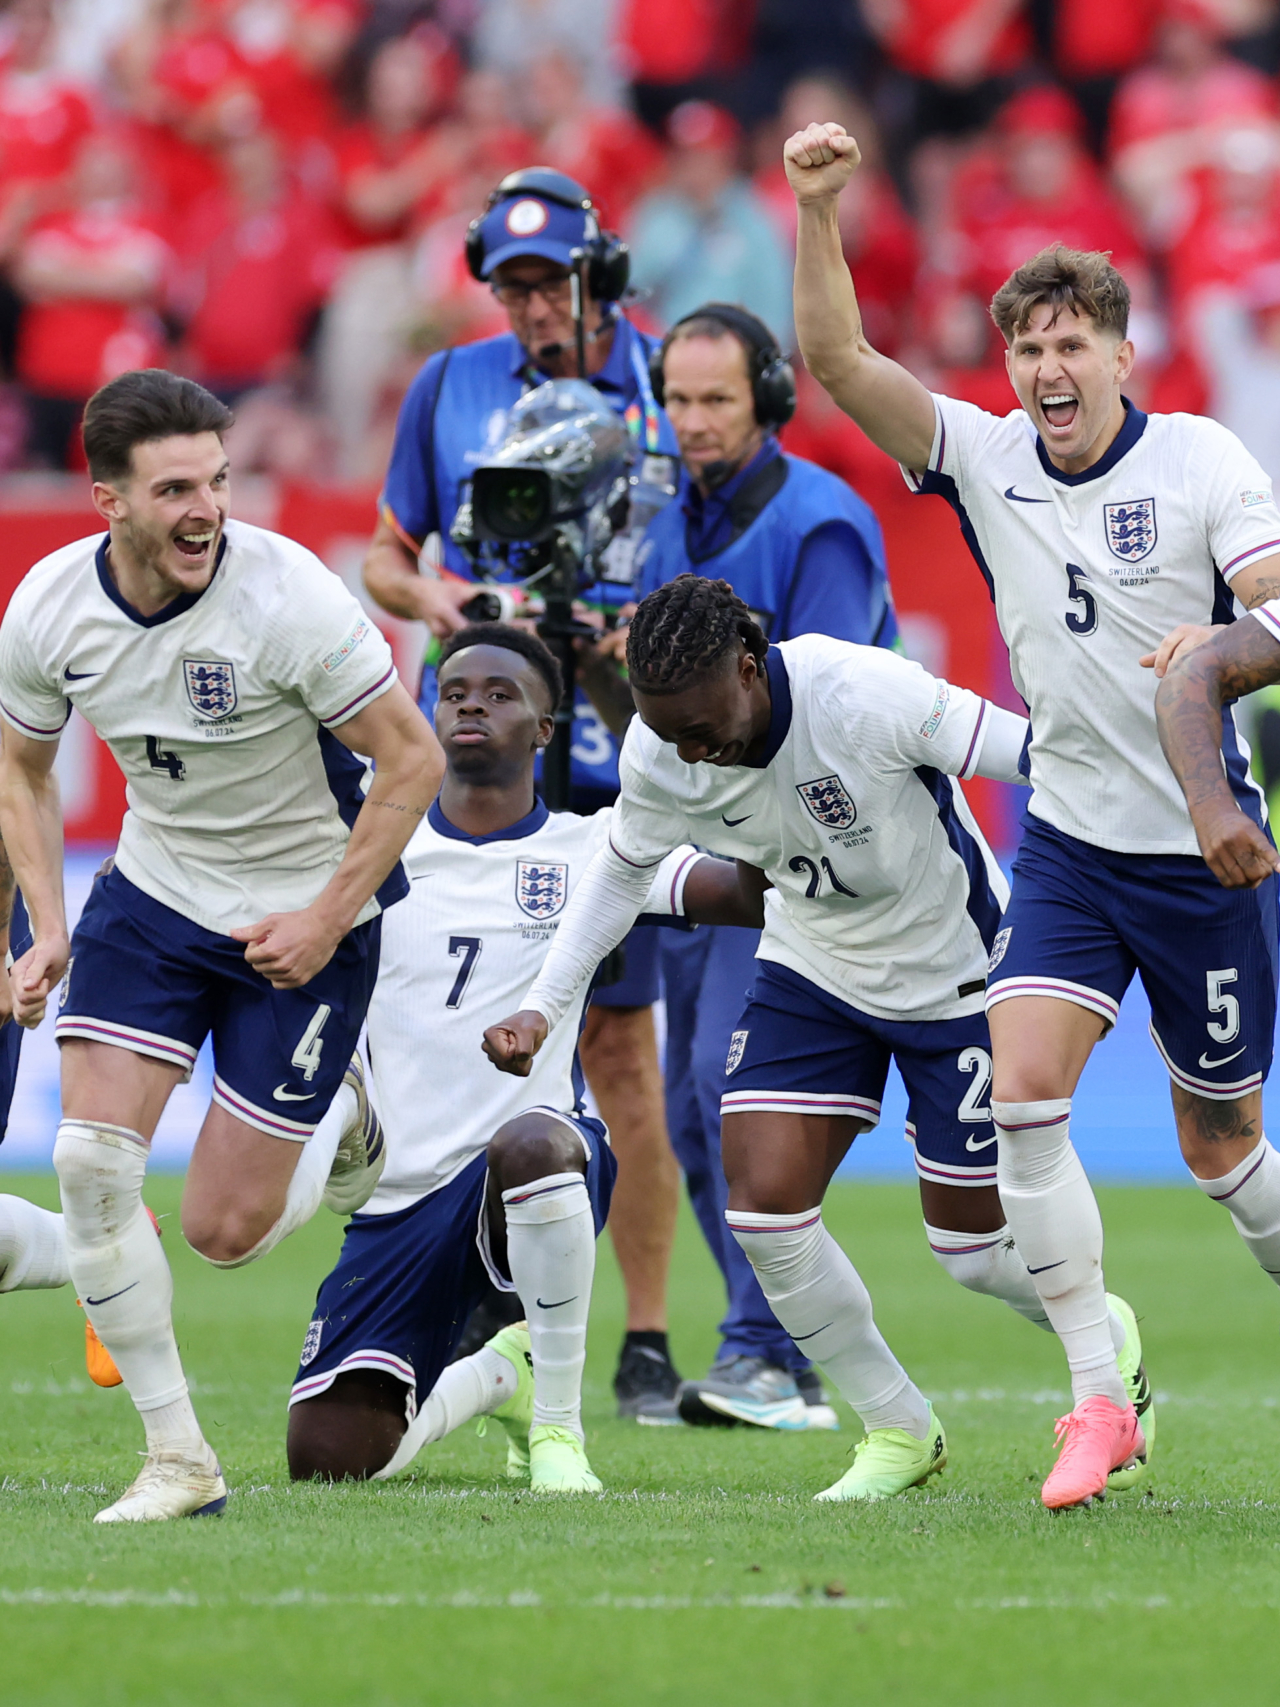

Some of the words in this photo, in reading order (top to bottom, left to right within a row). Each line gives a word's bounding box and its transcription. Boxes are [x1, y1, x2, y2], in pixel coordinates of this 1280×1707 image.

[1109, 566, 1159, 576] SWITZERLAND
[1120, 578, 1149, 586] 06.07.24
[1065, 563, 1098, 637] 5
[142, 734, 186, 781] 4
[829, 825, 873, 844] SWITZERLAND
[842, 836, 869, 848] 06.07.24
[788, 855, 861, 898] 21
[513, 921, 559, 930] SWITZERLAN
[446, 936, 483, 1010] 7
[1206, 967, 1240, 1044] 5
[290, 1003, 332, 1081] 4
